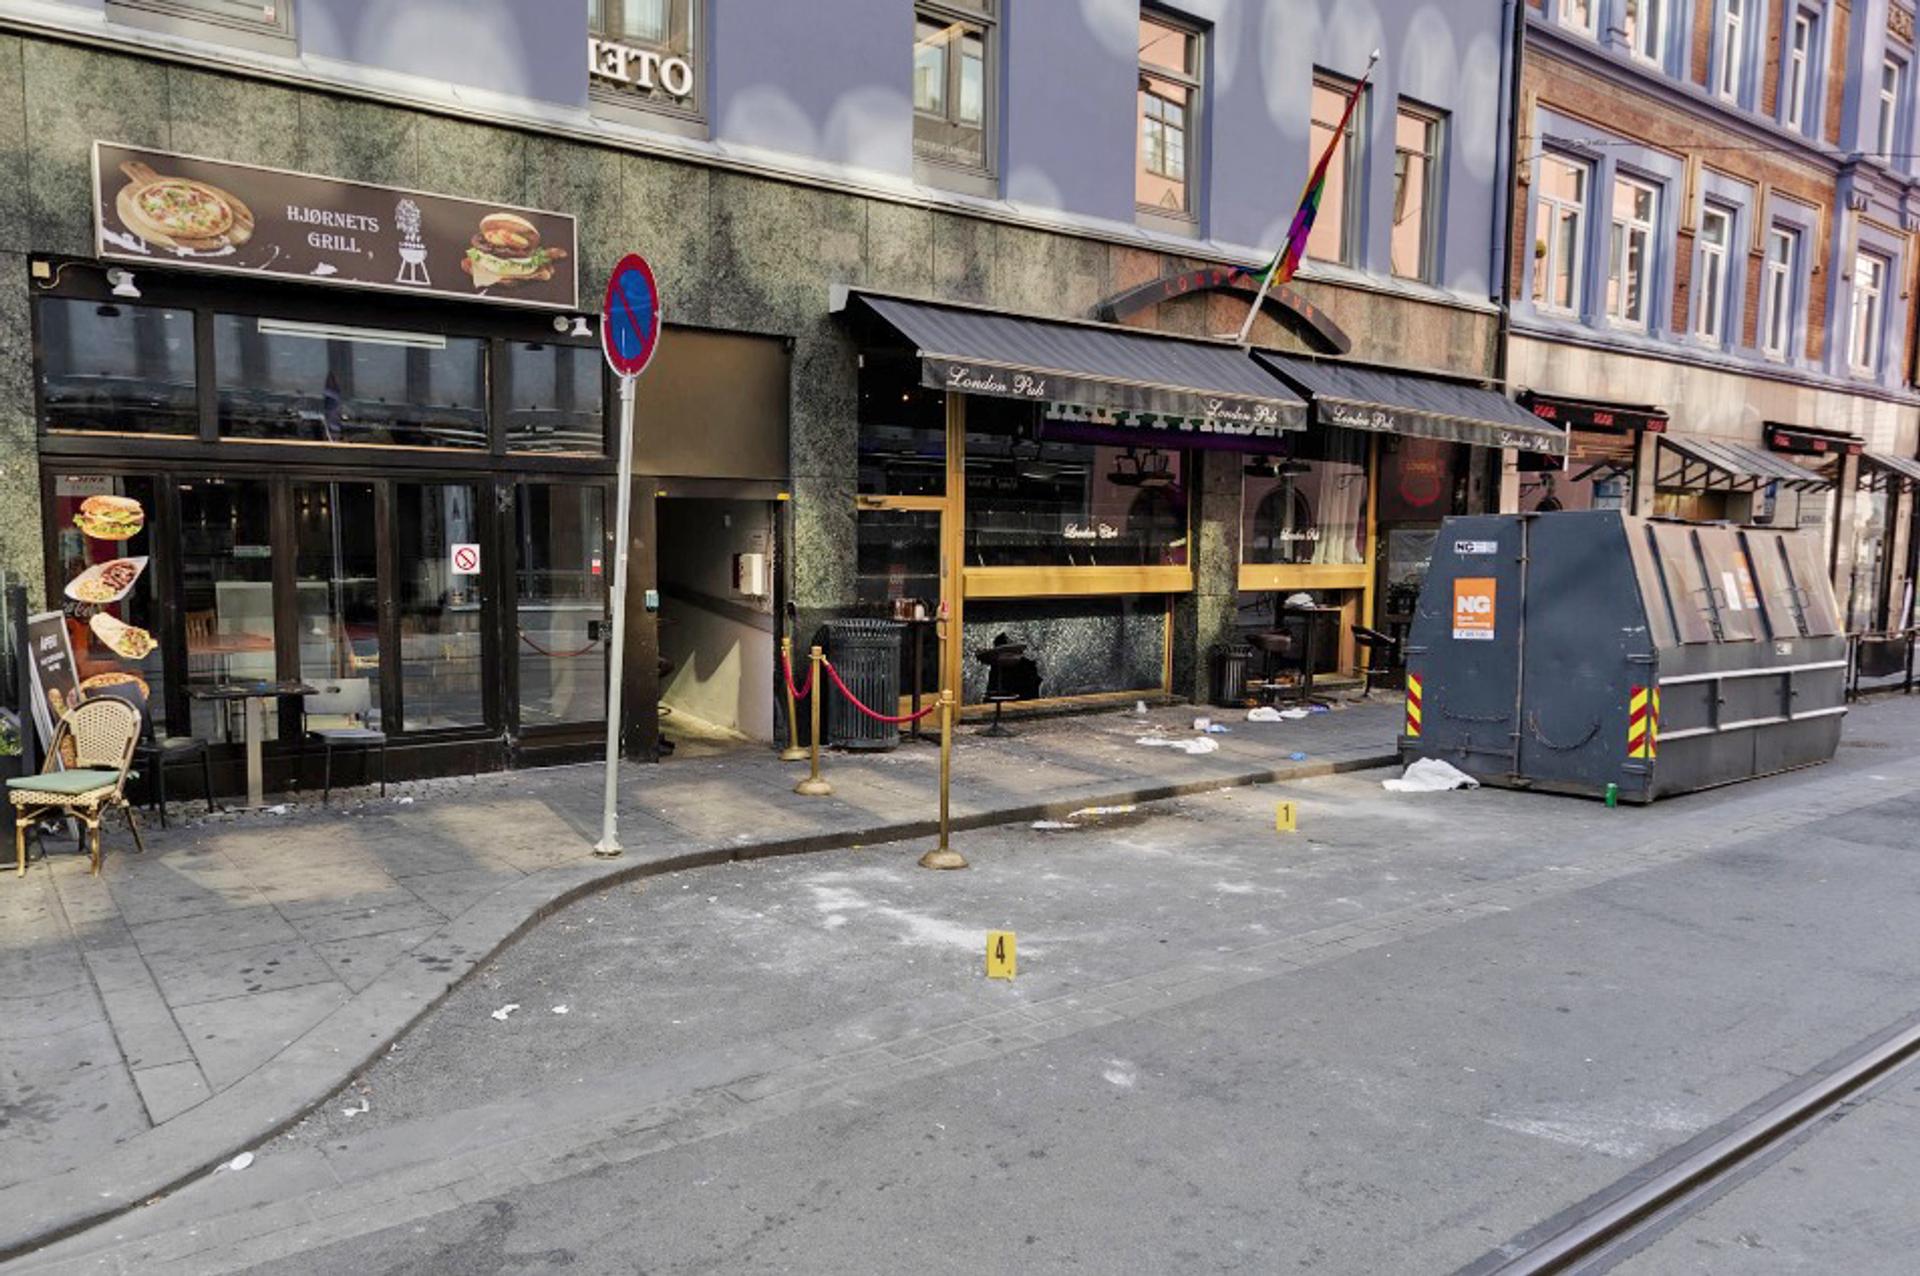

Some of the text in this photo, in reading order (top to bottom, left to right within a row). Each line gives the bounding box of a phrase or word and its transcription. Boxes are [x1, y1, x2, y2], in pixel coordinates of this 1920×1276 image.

[287, 205, 380, 233] HJØRNETS
[307, 231, 361, 253] GRILL
[946, 364, 1047, 397] London Pub
[1206, 399, 1252, 421] London
[1253, 404, 1279, 424] Pub
[1332, 405, 1396, 428] London Pub
[1456, 543, 1475, 552] NG
[1456, 595, 1491, 613] NG
[1283, 803, 1290, 822] 1
[996, 935, 1005, 965] 4
